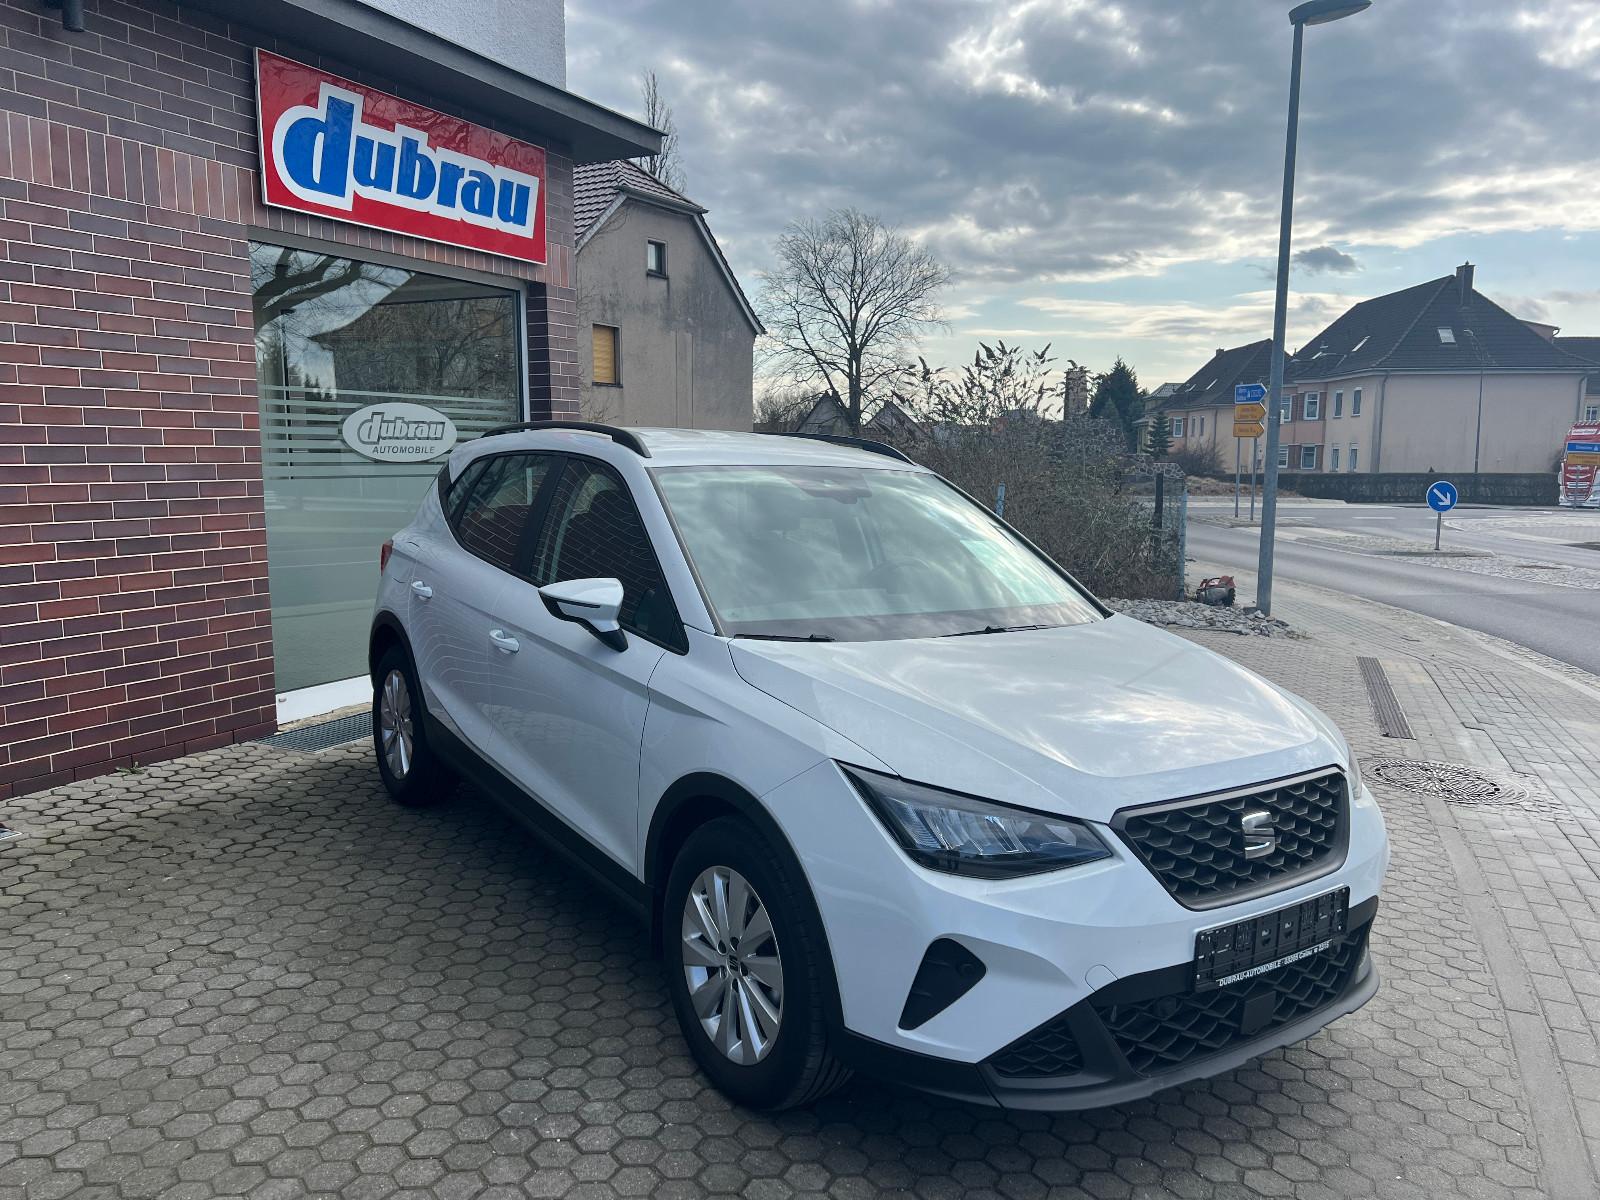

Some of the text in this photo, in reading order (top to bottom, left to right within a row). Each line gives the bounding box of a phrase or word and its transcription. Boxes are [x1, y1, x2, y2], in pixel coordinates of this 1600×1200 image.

[280, 93, 532, 228] dubrau
[357, 412, 446, 444] dubrau
[372, 446, 436, 454] AUTOMOBILE
